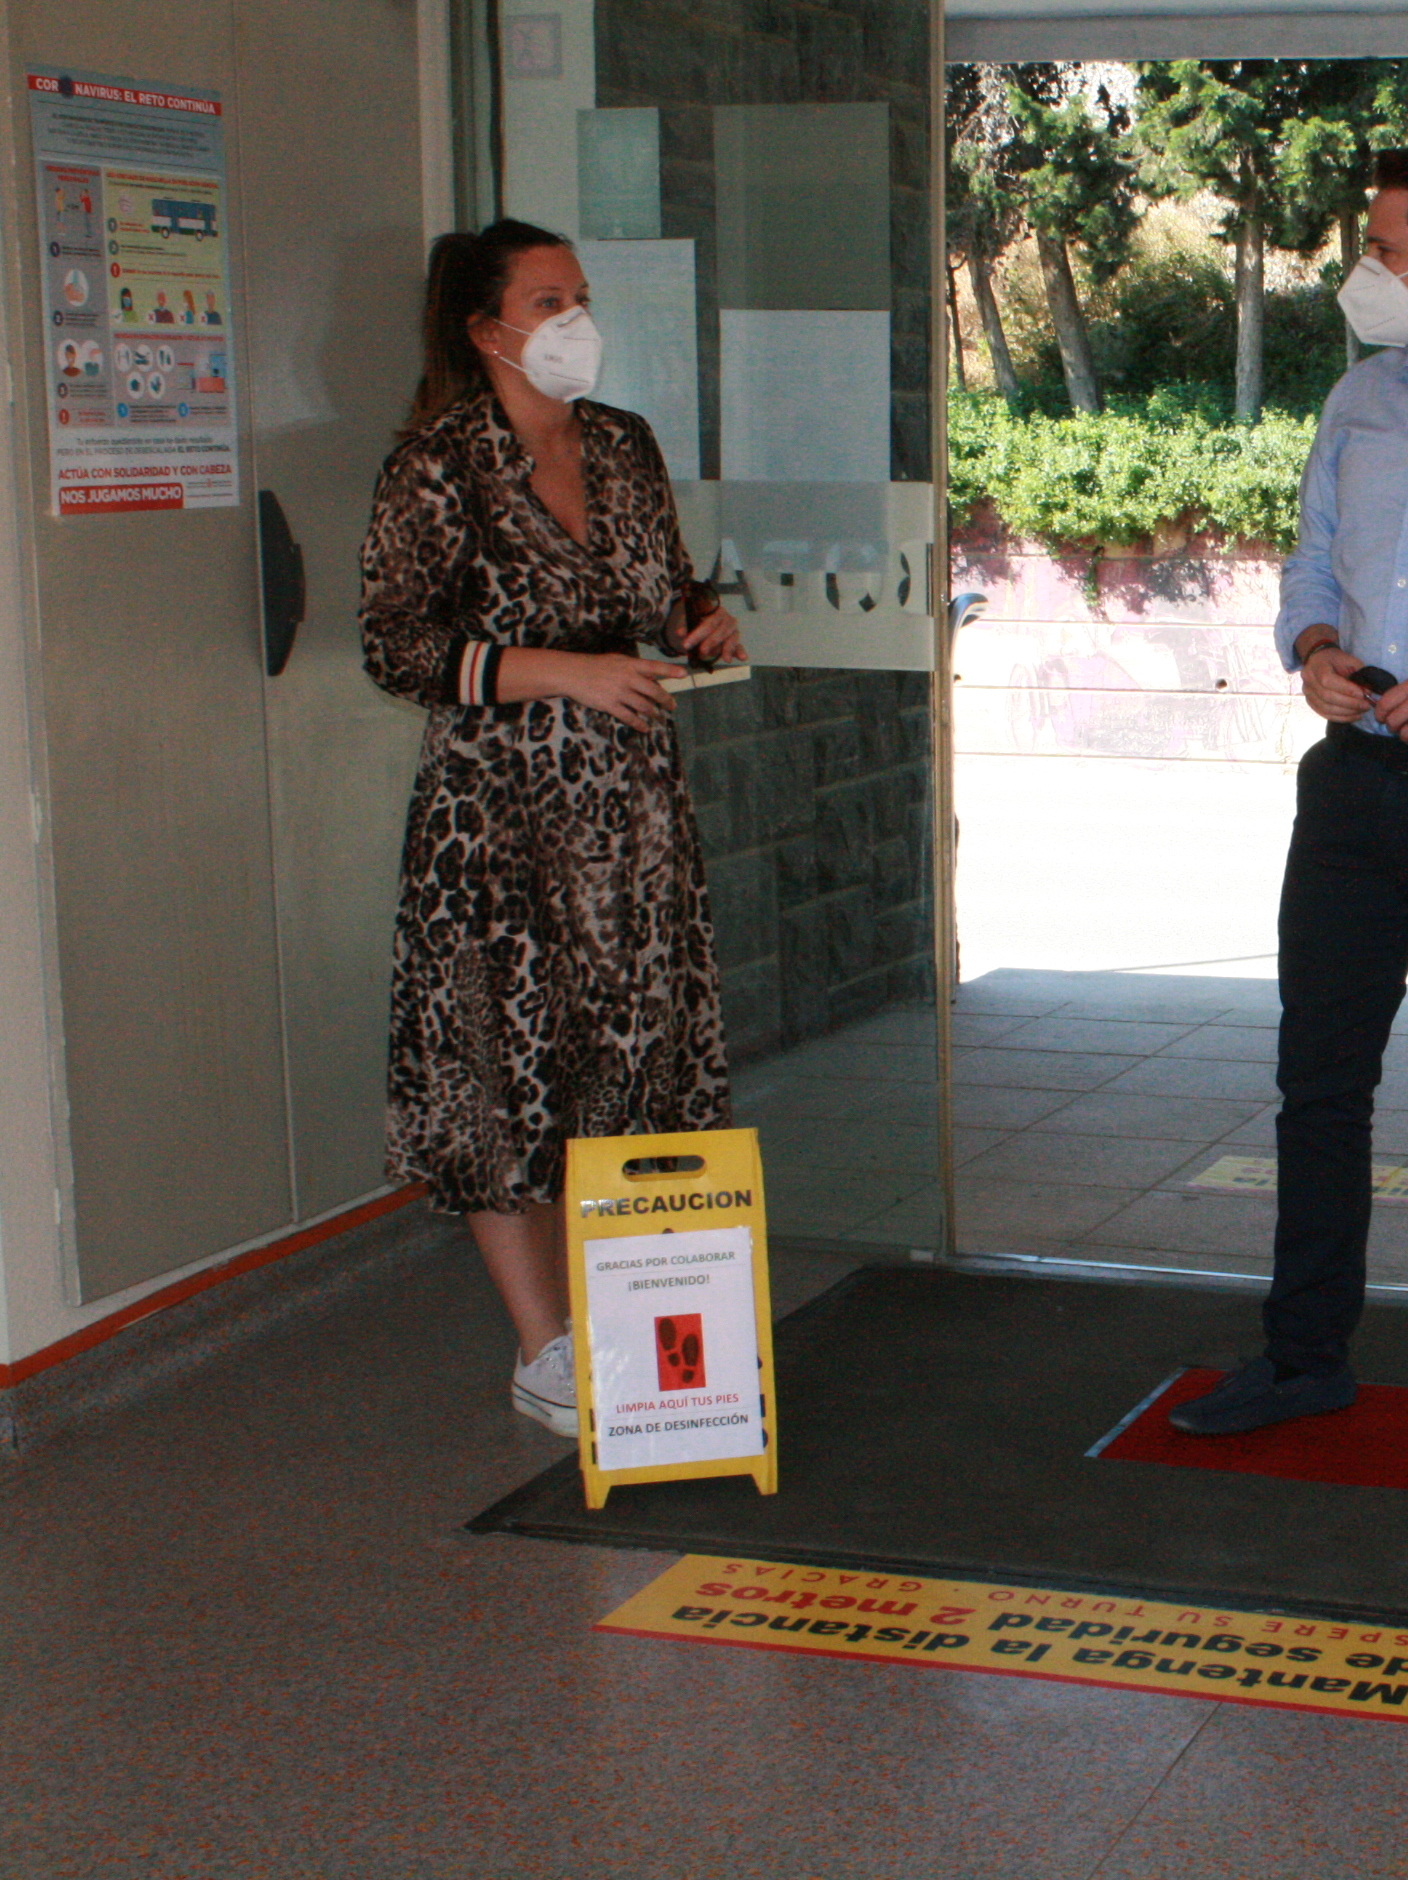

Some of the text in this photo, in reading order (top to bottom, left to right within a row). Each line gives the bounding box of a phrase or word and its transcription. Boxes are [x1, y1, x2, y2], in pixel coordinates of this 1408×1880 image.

[123, 91, 138, 103] EL
[138, 93, 166, 107] RETO
[92, 467, 113, 479] CON
[114, 465, 171, 478] SOLIDARIDAD
[173, 465, 179, 476] Y
[180, 465, 199, 476] CON
[199, 463, 232, 475] CABEZA
[60, 489, 87, 504] NOS
[88, 487, 142, 503] JUGAMOS
[142, 486, 183, 501] MUCHO
[580, 1189, 753, 1218] PRECAUCION
[596, 1250, 736, 1272] GRACIAS POR COLABORAR
[627, 1273, 711, 1292] ¡BIENVENIDO!
[616, 1401, 656, 1414] LIMPIA
[691, 1395, 713, 1407] TUS
[715, 1392, 739, 1404] PIES
[608, 1412, 749, 1437] ZONA DE DESINFECCIÓN
[722, 1562, 923, 1593] GRACIAS
[695, 1582, 919, 1617] metros
[987, 1590, 1146, 1618] TURNO
[929, 1605, 977, 1626] 2
[1176, 1611, 1234, 1628] SU
[671, 1605, 970, 1652] distancia
[987, 1612, 1324, 1663] seguridad
[990, 1638, 1053, 1663] la
